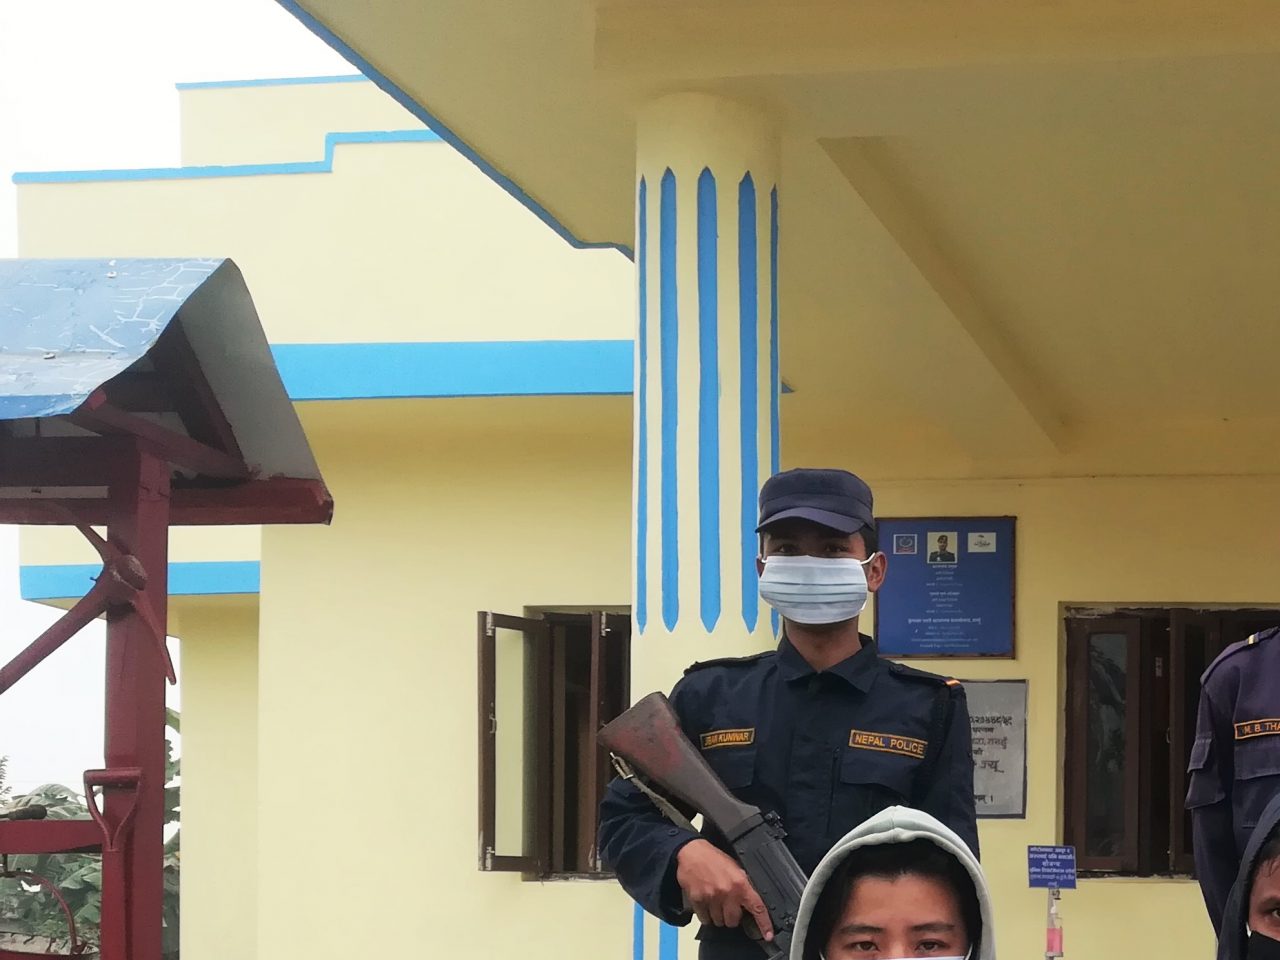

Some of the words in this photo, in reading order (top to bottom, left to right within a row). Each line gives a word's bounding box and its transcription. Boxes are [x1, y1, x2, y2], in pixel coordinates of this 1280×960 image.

[719, 732, 749, 743] KUNWAR
[855, 734, 886, 747] NEPAL
[890, 739, 924, 754] POLICE
